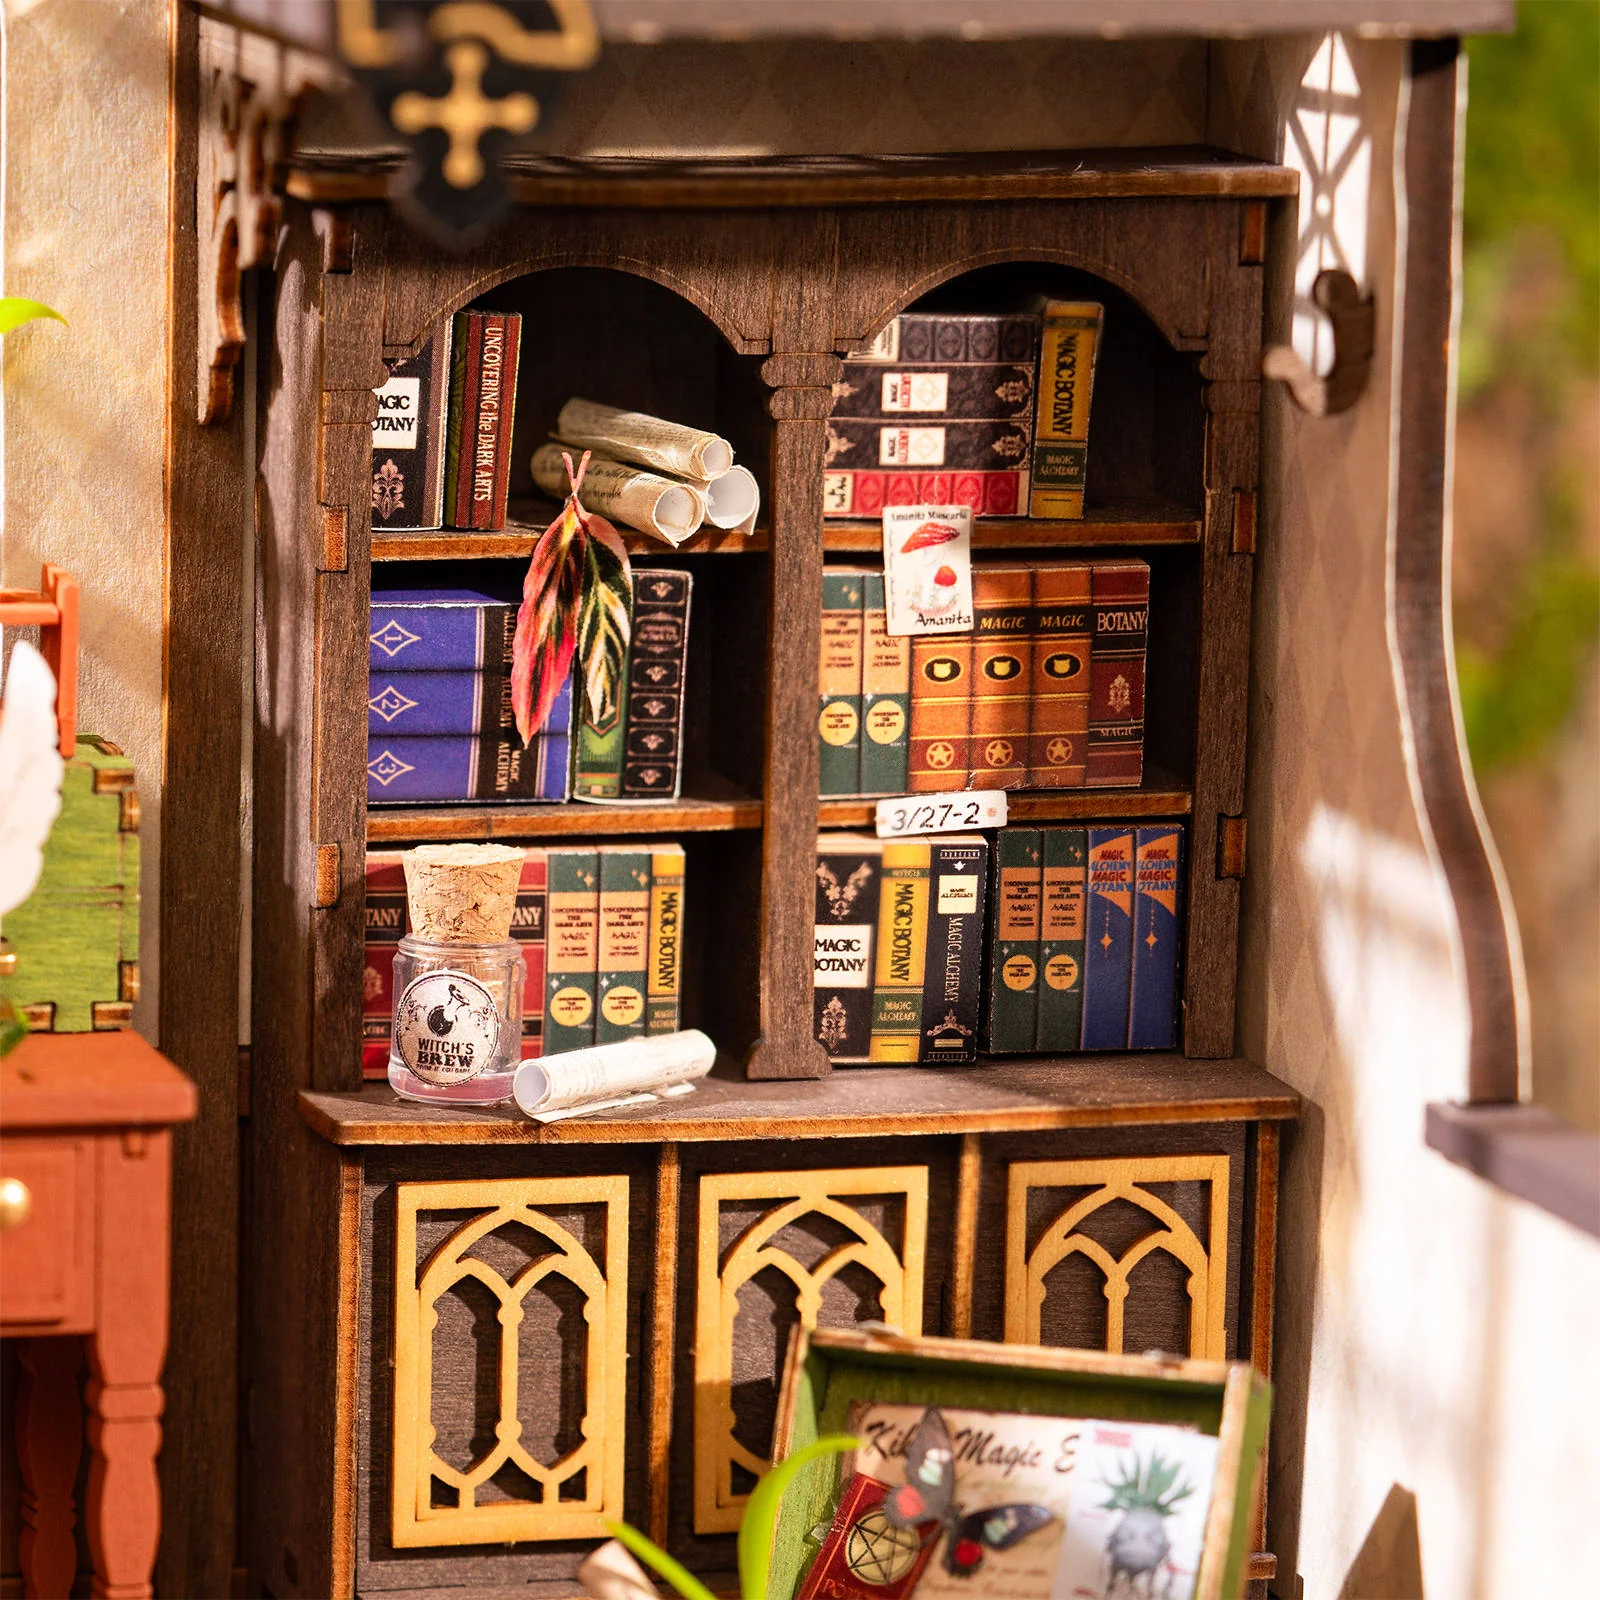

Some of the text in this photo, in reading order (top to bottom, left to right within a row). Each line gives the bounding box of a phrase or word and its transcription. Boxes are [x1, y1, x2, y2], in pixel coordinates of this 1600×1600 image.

[474, 327, 503, 501] UNCOVERING the DARK ARTS
[1053, 379, 1074, 435] BOTANY
[915, 610, 972, 626] Amanita
[979, 616, 1025, 630] MAGIC
[1040, 614, 1085, 628] MAGIC
[1096, 610, 1147, 632] BOTANY
[381, 699, 400, 710] 2
[378, 763, 397, 775] 3
[495, 741, 510, 792] ALCHEMY
[891, 801, 981, 831] 3/27-2
[1090, 871, 1127, 882] MAGIC
[660, 891, 678, 935] MAGIC
[895, 882, 914, 926] MAGIC
[814, 939, 861, 952] MAGIC
[891, 927, 912, 982] BOTANY
[658, 935, 677, 989] BOTANY
[944, 916, 964, 1002] MAGIC ALCHEMY
[417, 1051, 475, 1068] BREW
[418, 1038, 475, 1055] WITCH'S
[954, 1429, 1042, 1478] Magic
